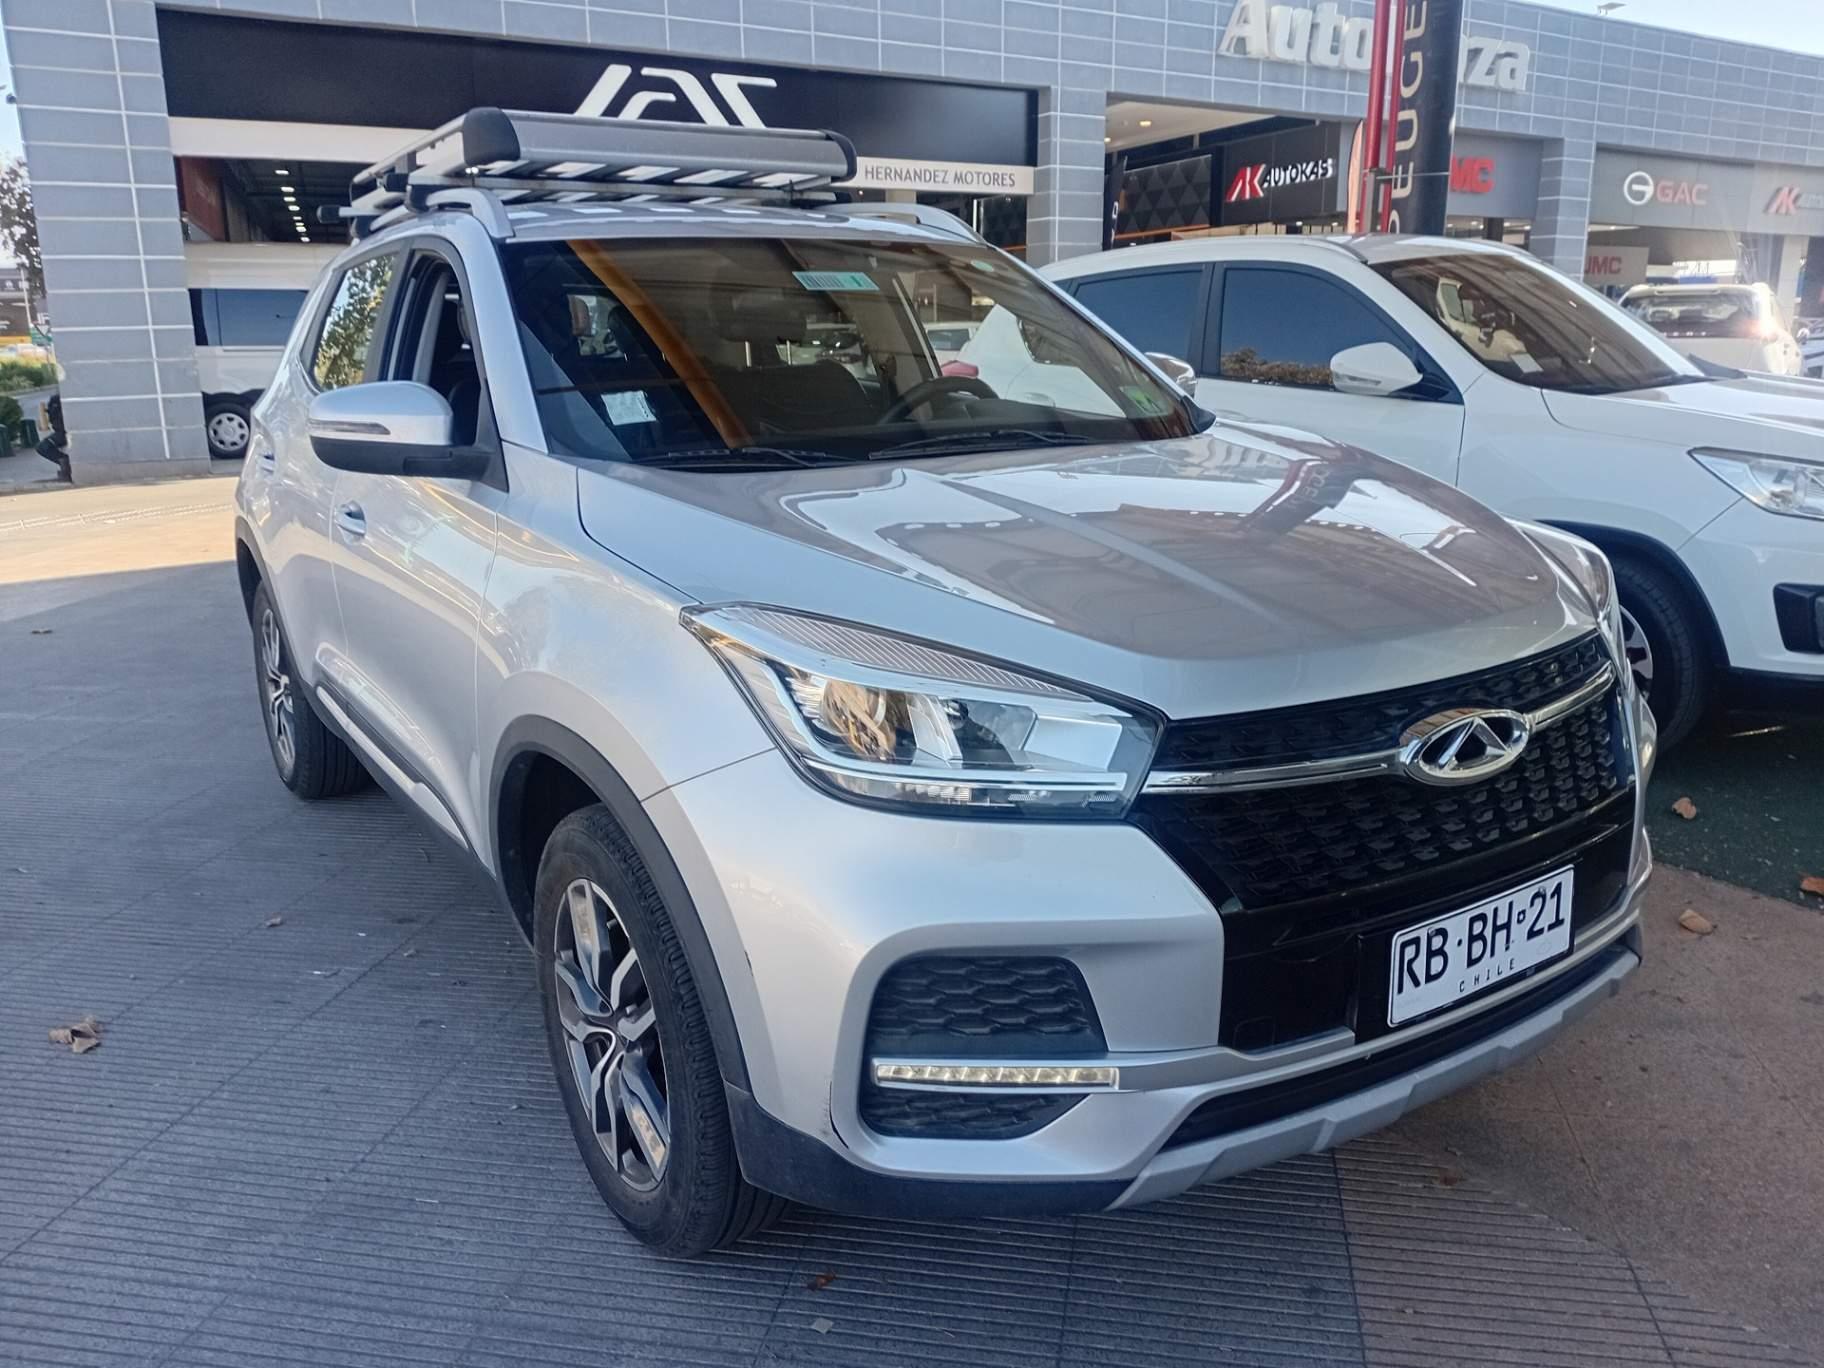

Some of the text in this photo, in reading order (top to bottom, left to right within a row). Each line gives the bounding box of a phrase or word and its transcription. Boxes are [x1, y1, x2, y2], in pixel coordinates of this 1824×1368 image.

[864, 164, 1016, 188] HERNANDEZ MOTORES
[1262, 157, 1334, 188] AUTOKAS
[1656, 180, 1709, 206] GAC
[1459, 958, 1516, 993] CHILE
